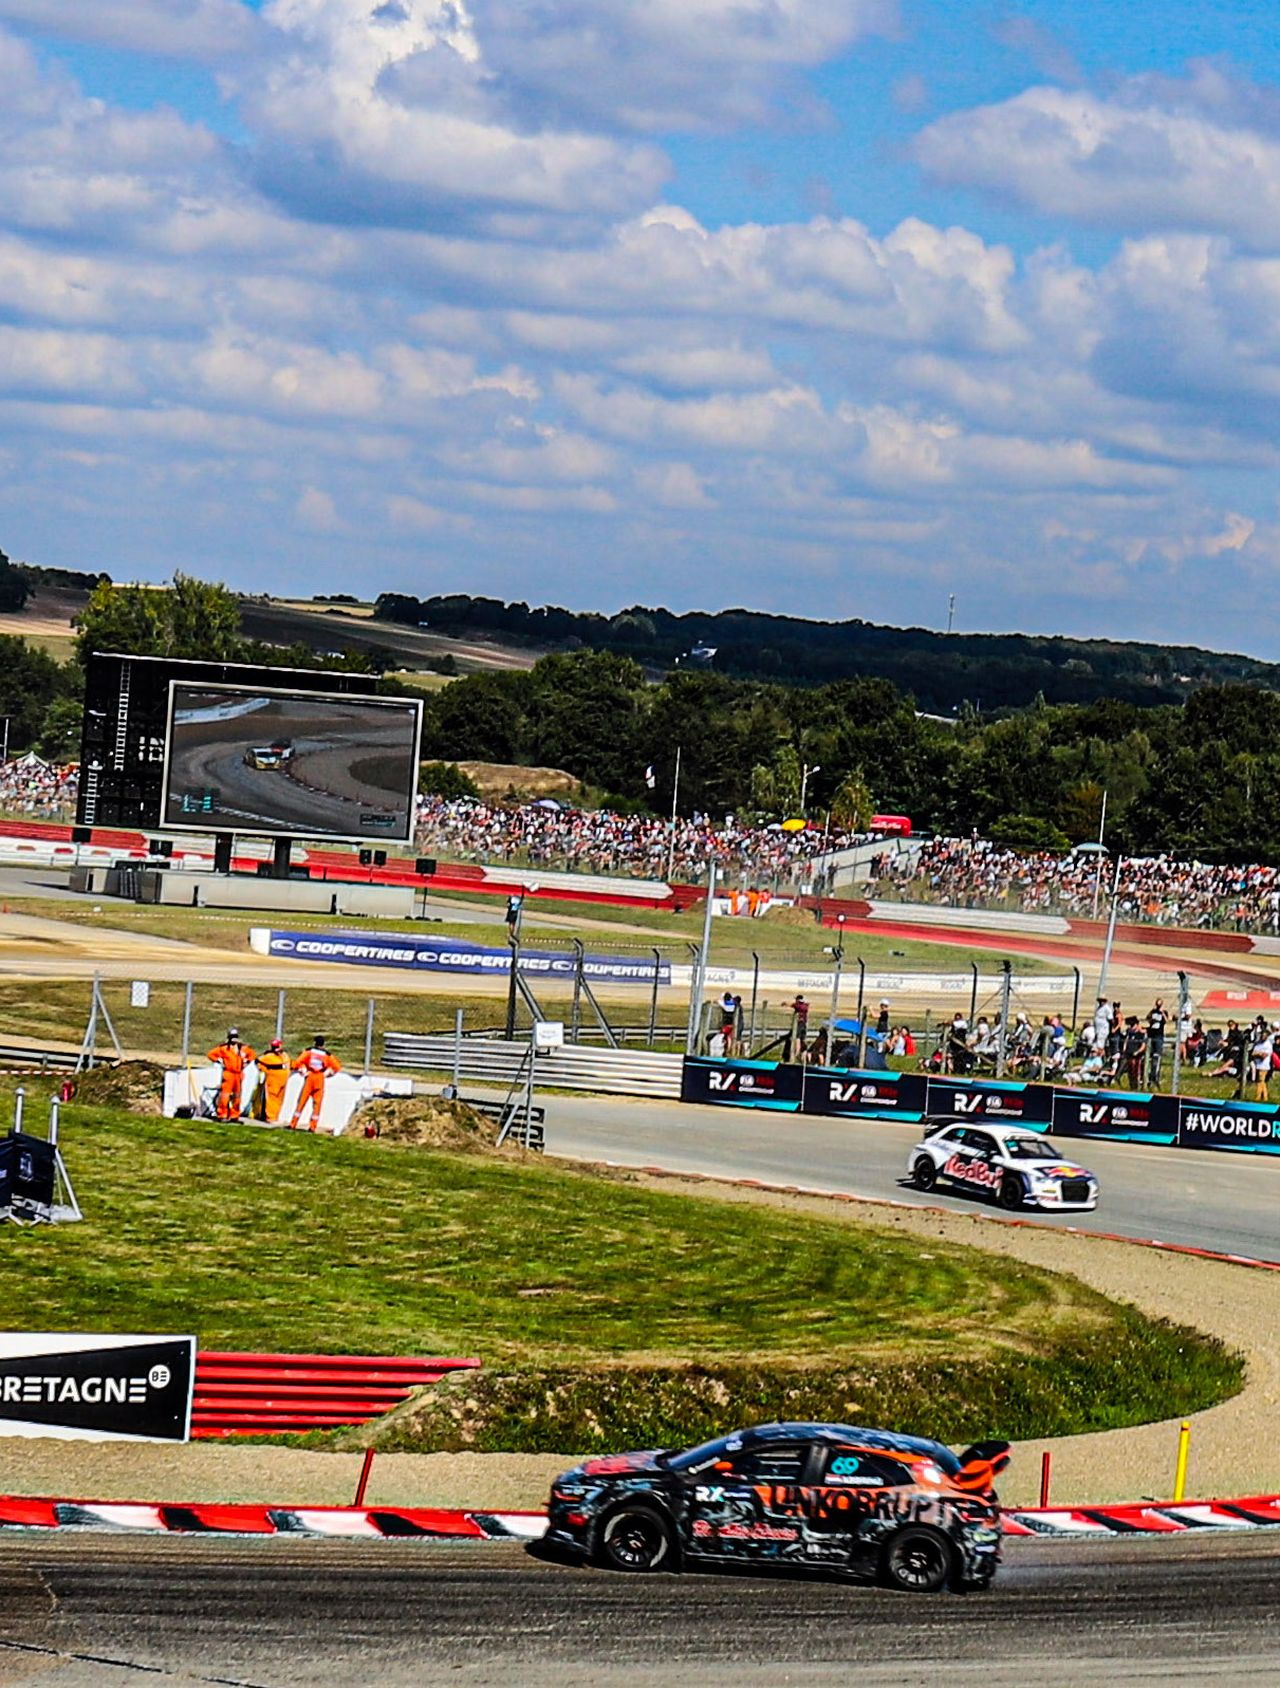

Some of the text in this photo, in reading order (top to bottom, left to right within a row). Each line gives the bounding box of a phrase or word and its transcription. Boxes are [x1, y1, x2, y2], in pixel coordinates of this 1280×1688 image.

[296, 941, 416, 962] COOPERTIRES
[439, 952, 551, 971] COOPERTRES
[830, 1455, 860, 1476] 69
[695, 1485, 725, 1502] RX
